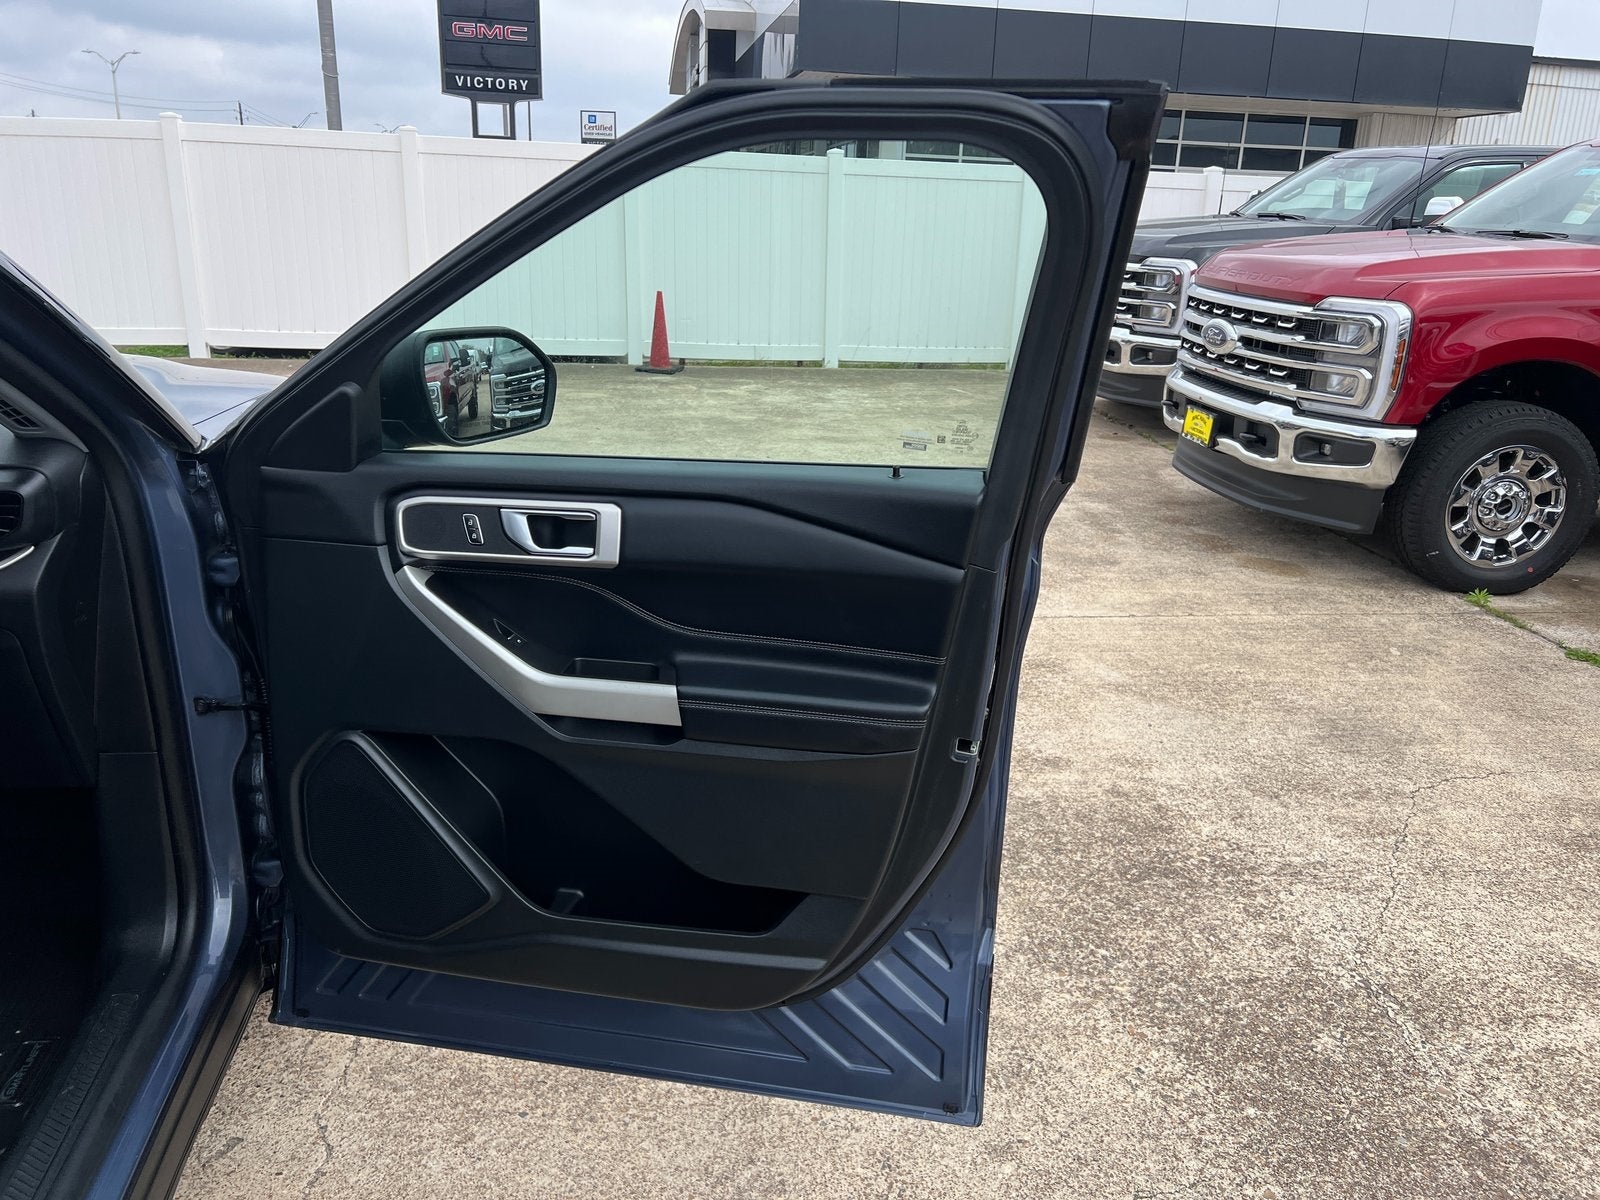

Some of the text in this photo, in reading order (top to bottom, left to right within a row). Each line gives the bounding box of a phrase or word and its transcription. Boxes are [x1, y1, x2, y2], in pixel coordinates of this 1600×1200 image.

[452, 21, 528, 41] GMC
[455, 75, 529, 91] VICTORY
[583, 123, 613, 132] Certified
